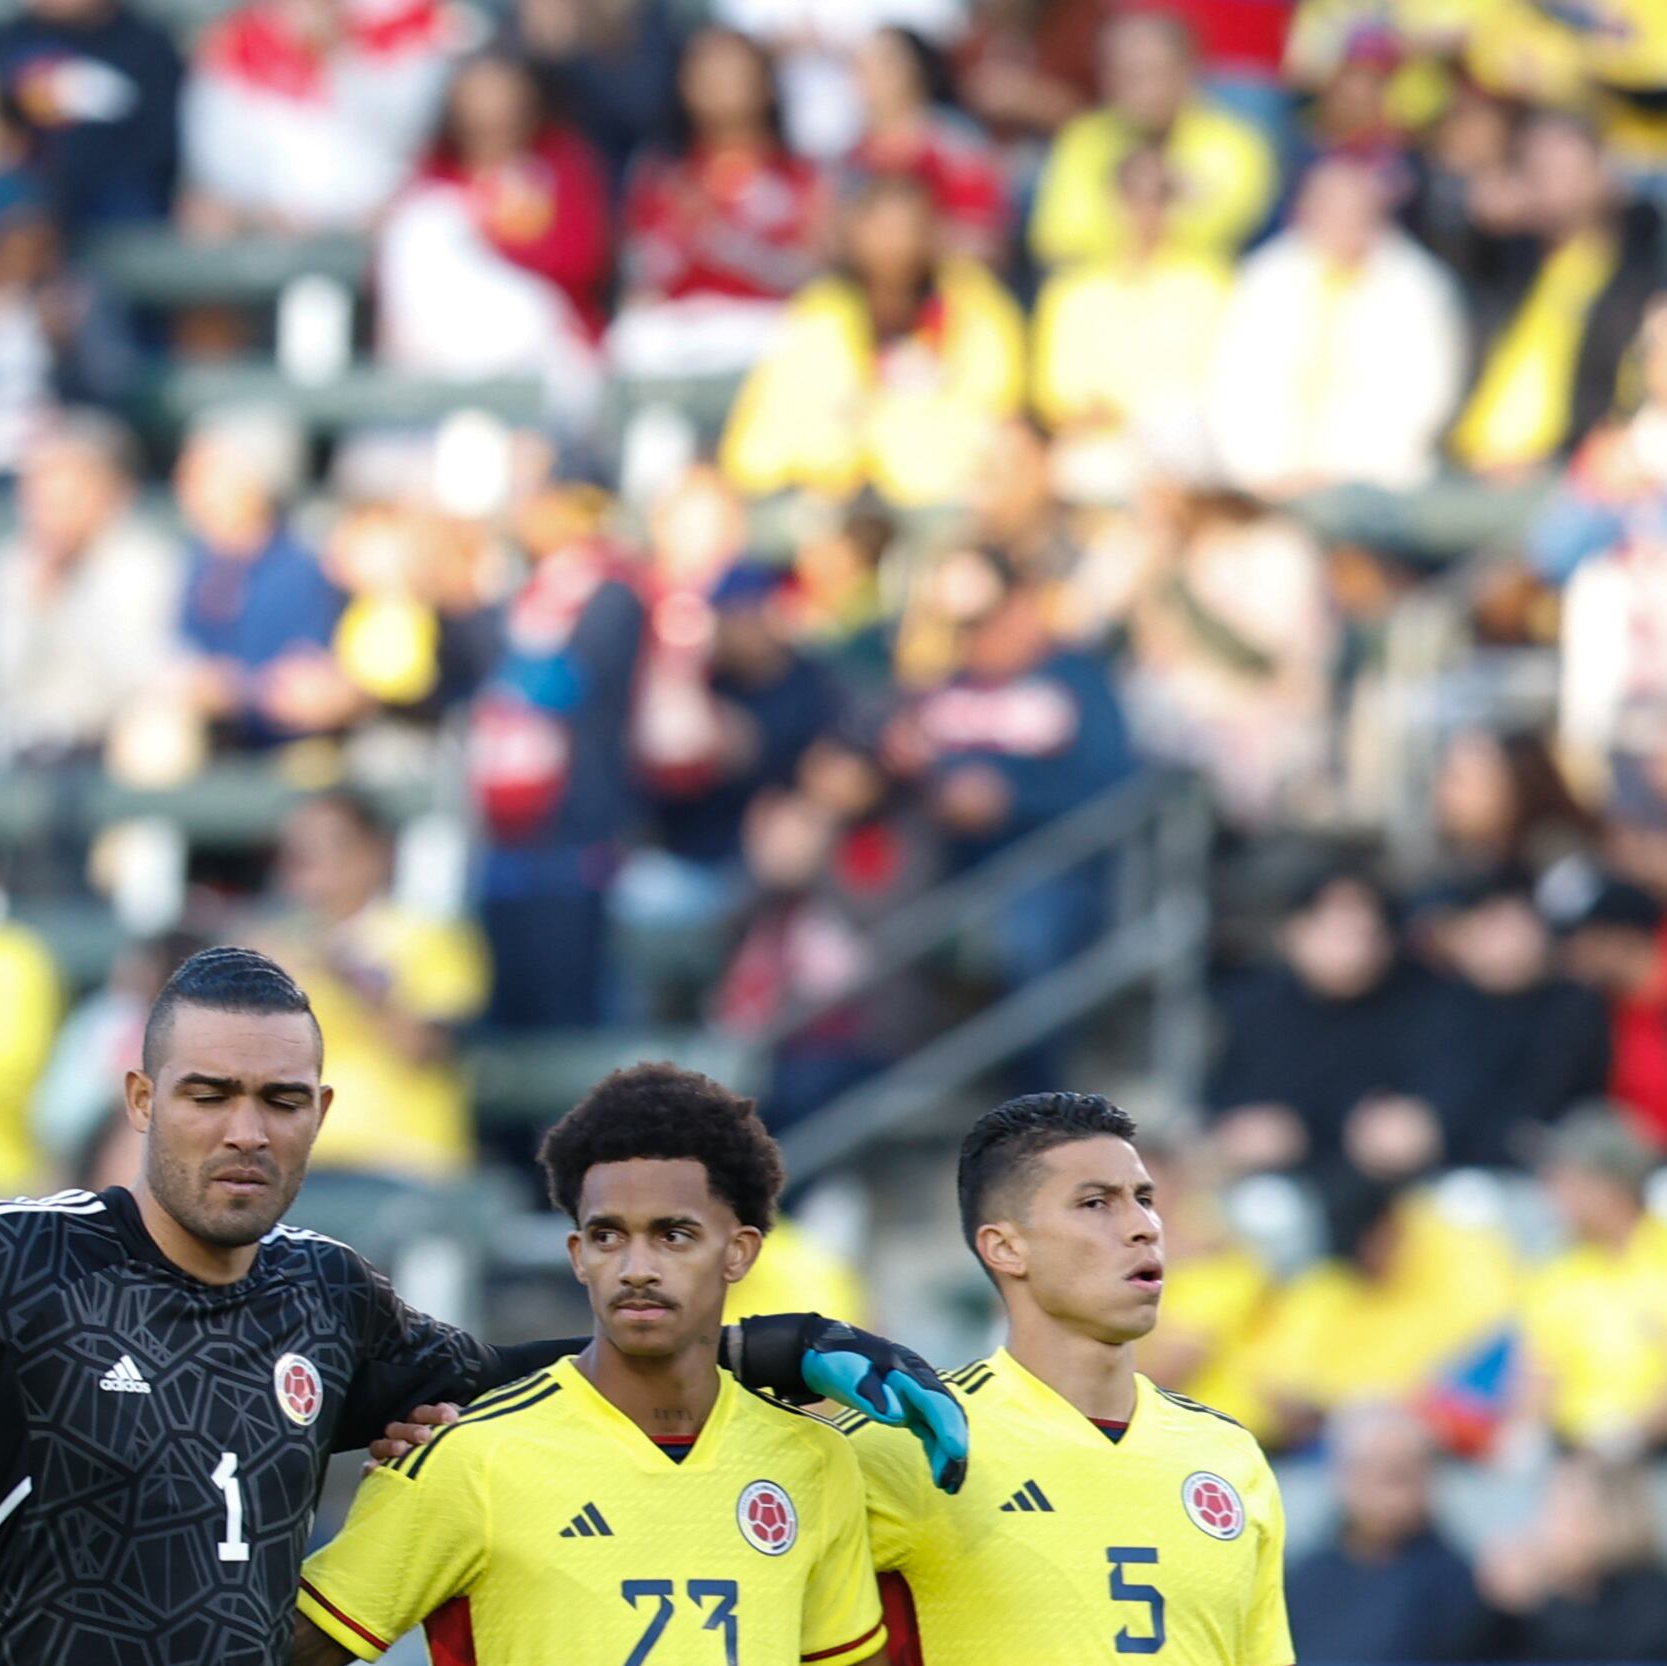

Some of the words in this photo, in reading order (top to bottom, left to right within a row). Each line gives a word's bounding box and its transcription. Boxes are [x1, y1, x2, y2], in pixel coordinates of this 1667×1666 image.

[99, 1378, 152, 1394] adidas
[211, 1453, 249, 1561] 1
[1107, 1547, 1165, 1655] 5
